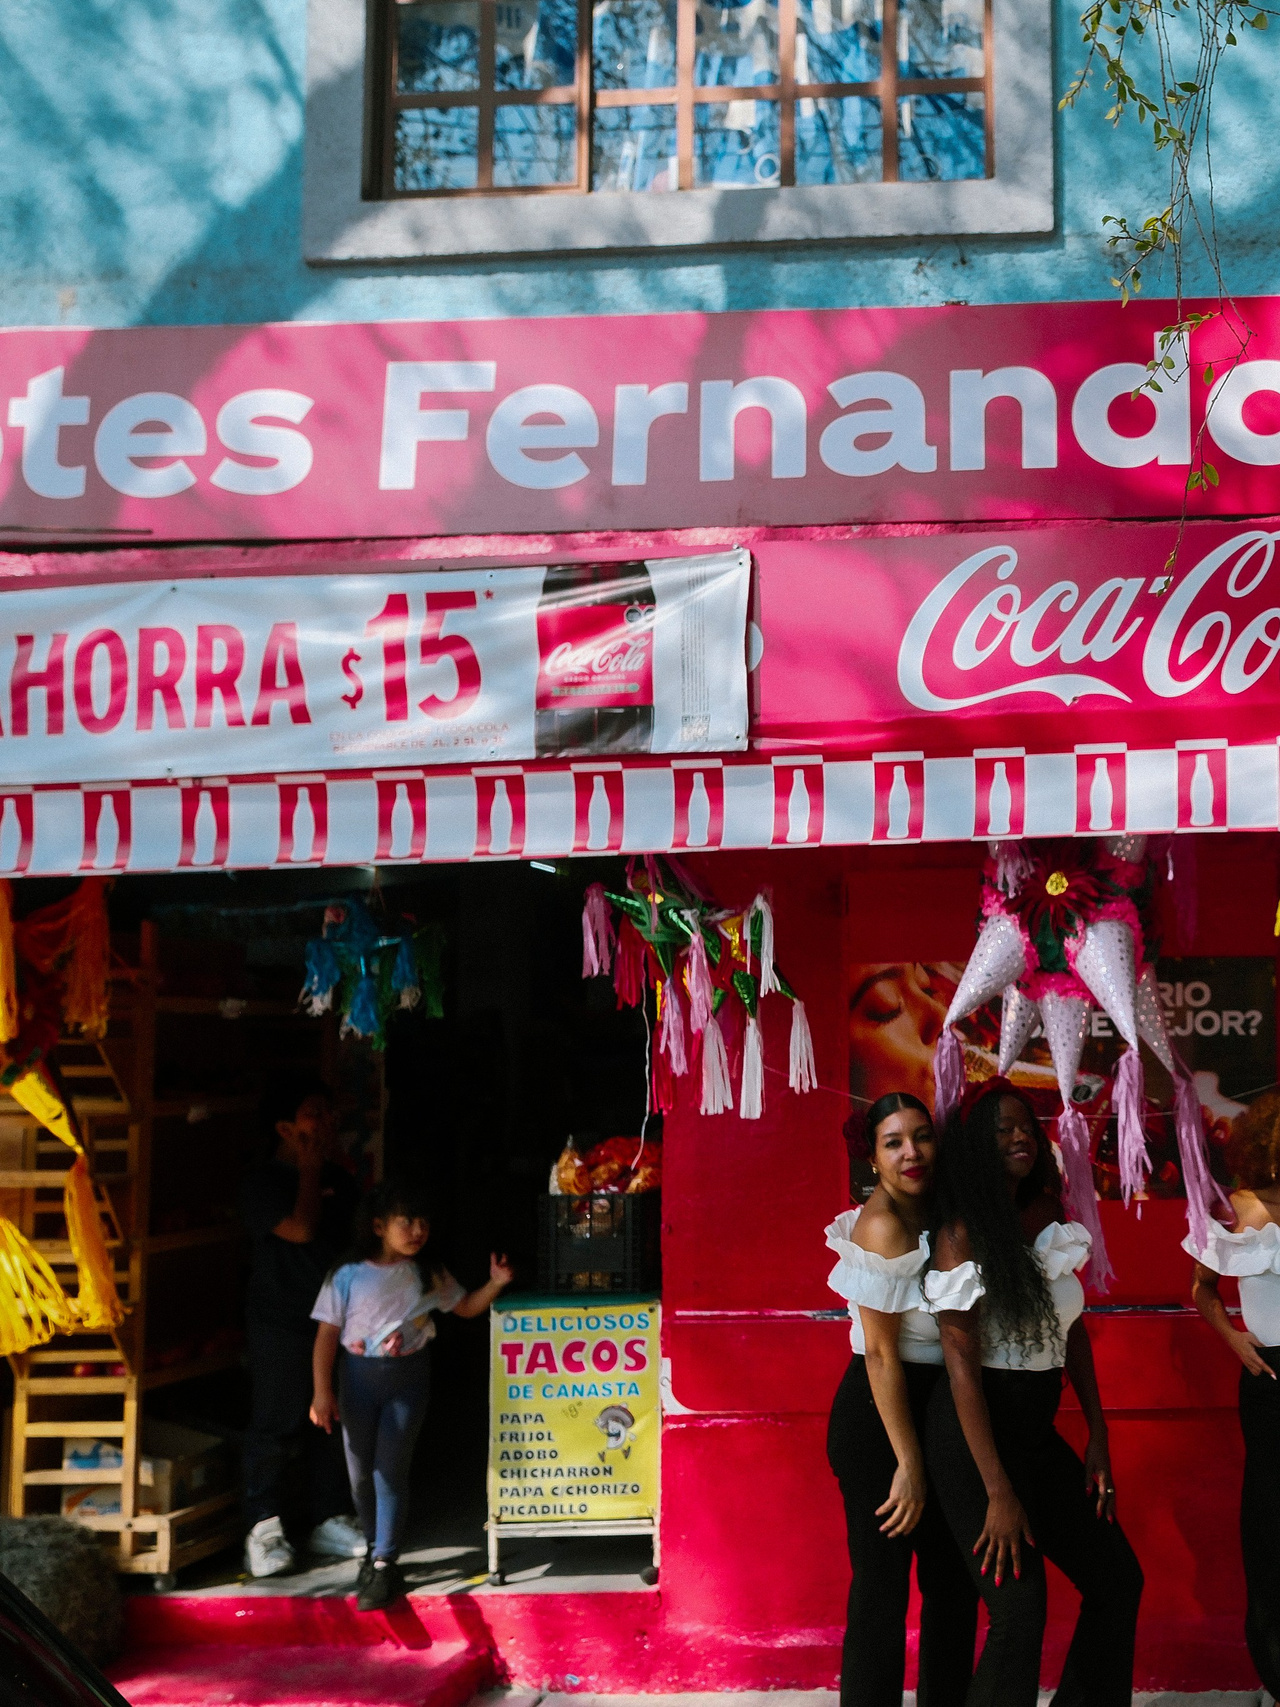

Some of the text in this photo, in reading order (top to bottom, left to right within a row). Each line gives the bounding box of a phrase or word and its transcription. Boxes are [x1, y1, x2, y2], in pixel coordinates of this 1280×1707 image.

[0, 365, 315, 500] tes
[0, 621, 312, 738] HORRA
[503, 1312, 650, 1333] DELICIOSOS
[500, 1338, 648, 1375] TACOS
[508, 1382, 640, 1399] DE CANASTA
[500, 1412, 545, 1425] PAPA
[500, 1431, 555, 1443] FRIJOL
[500, 1449, 559, 1461] ADOBO
[500, 1466, 613, 1479] CHICHARRON
[500, 1486, 544, 1498] PAPA
[500, 1503, 588, 1516] PICADILLO
